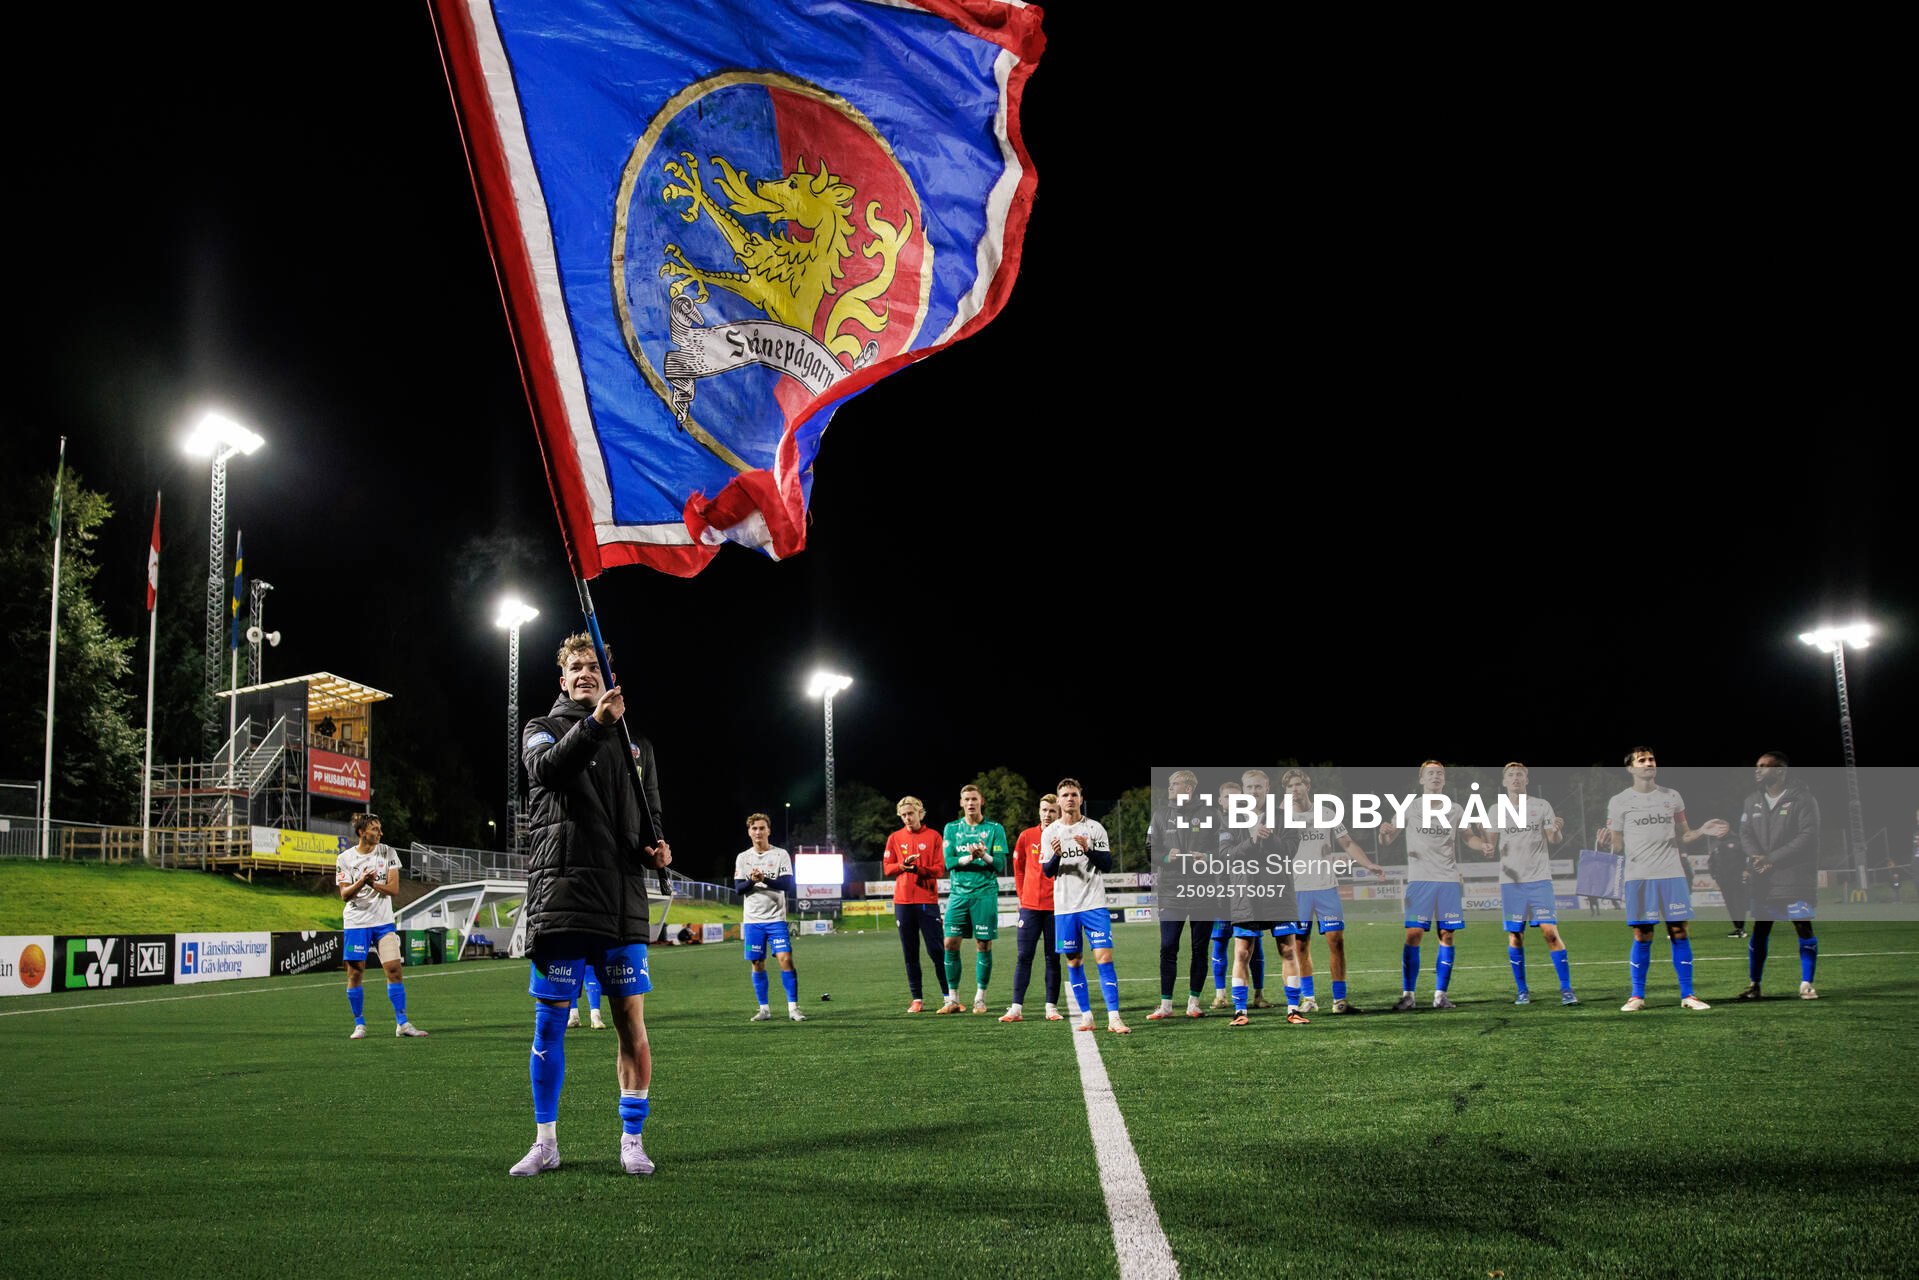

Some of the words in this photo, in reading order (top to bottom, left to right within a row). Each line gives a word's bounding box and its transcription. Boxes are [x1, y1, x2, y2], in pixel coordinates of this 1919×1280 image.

[313, 770, 323, 782] PP
[357, 780, 367, 790] AB
[201, 939, 268, 957] Länsförsäkringar
[280, 936, 338, 971] reklamhuset
[139, 947, 162, 972] XL
[200, 958, 242, 975] Gävleborg
[548, 965, 573, 977] Solid
[605, 964, 635, 977] Fibio
